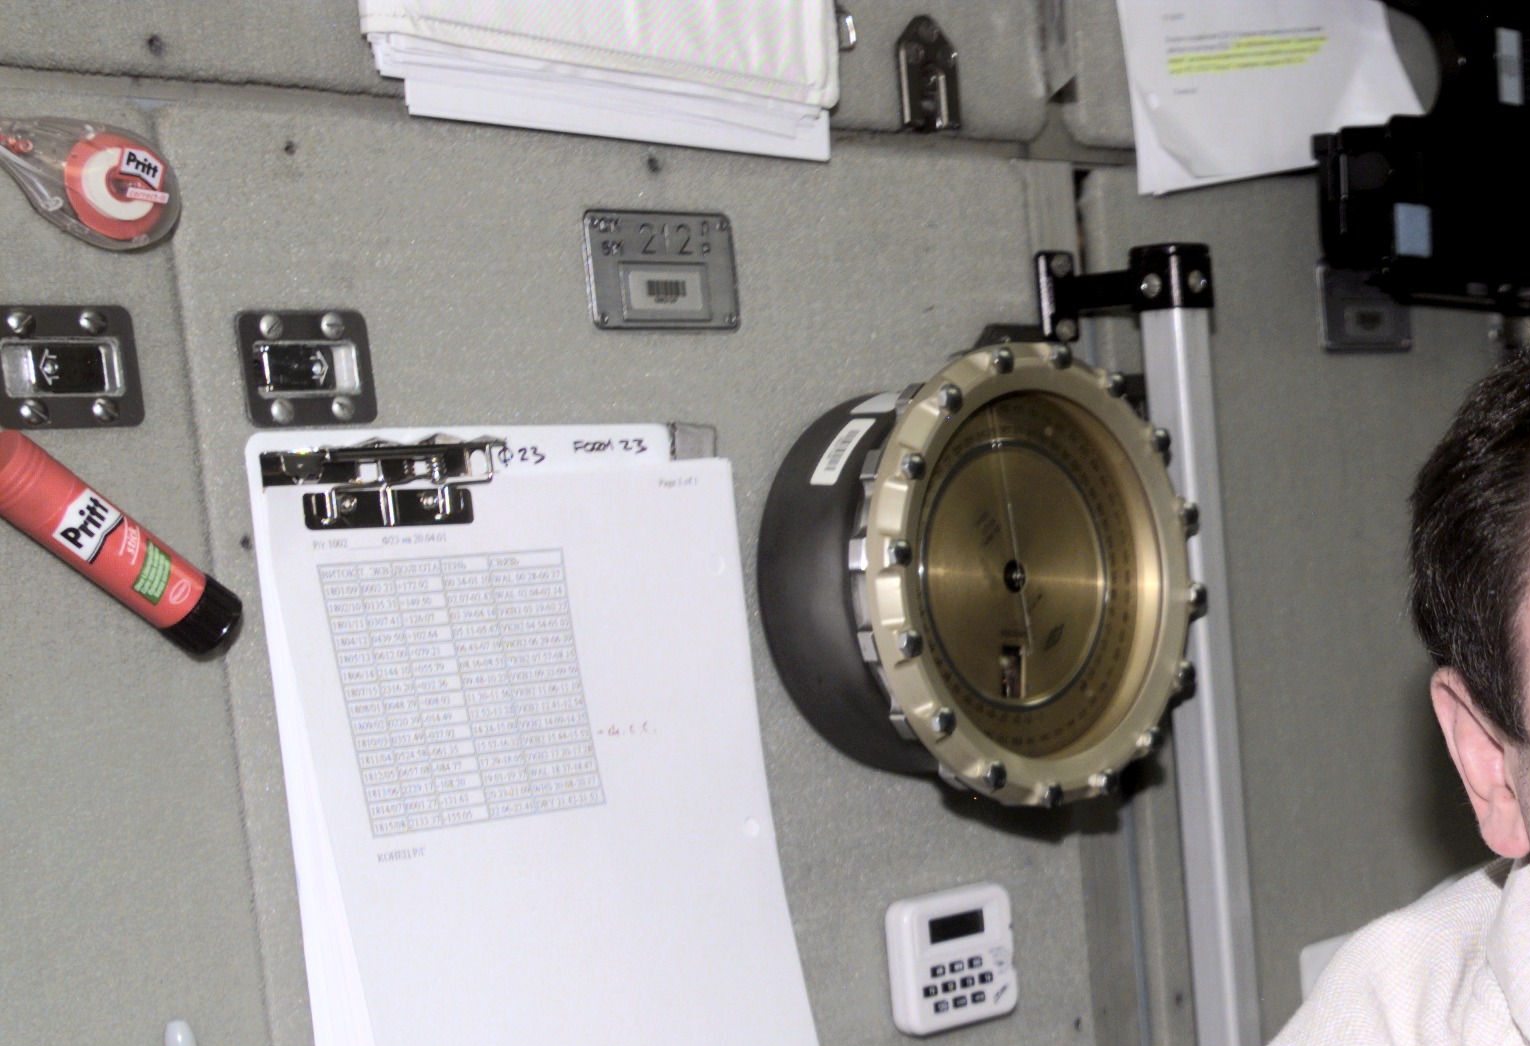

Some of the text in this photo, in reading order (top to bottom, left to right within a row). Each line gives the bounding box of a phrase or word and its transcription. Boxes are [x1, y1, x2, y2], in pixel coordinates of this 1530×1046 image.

[126, 151, 158, 177] Pritt
[518, 446, 546, 464] 23
[619, 437, 648, 454] 23
[60, 496, 109, 549] Pritt
